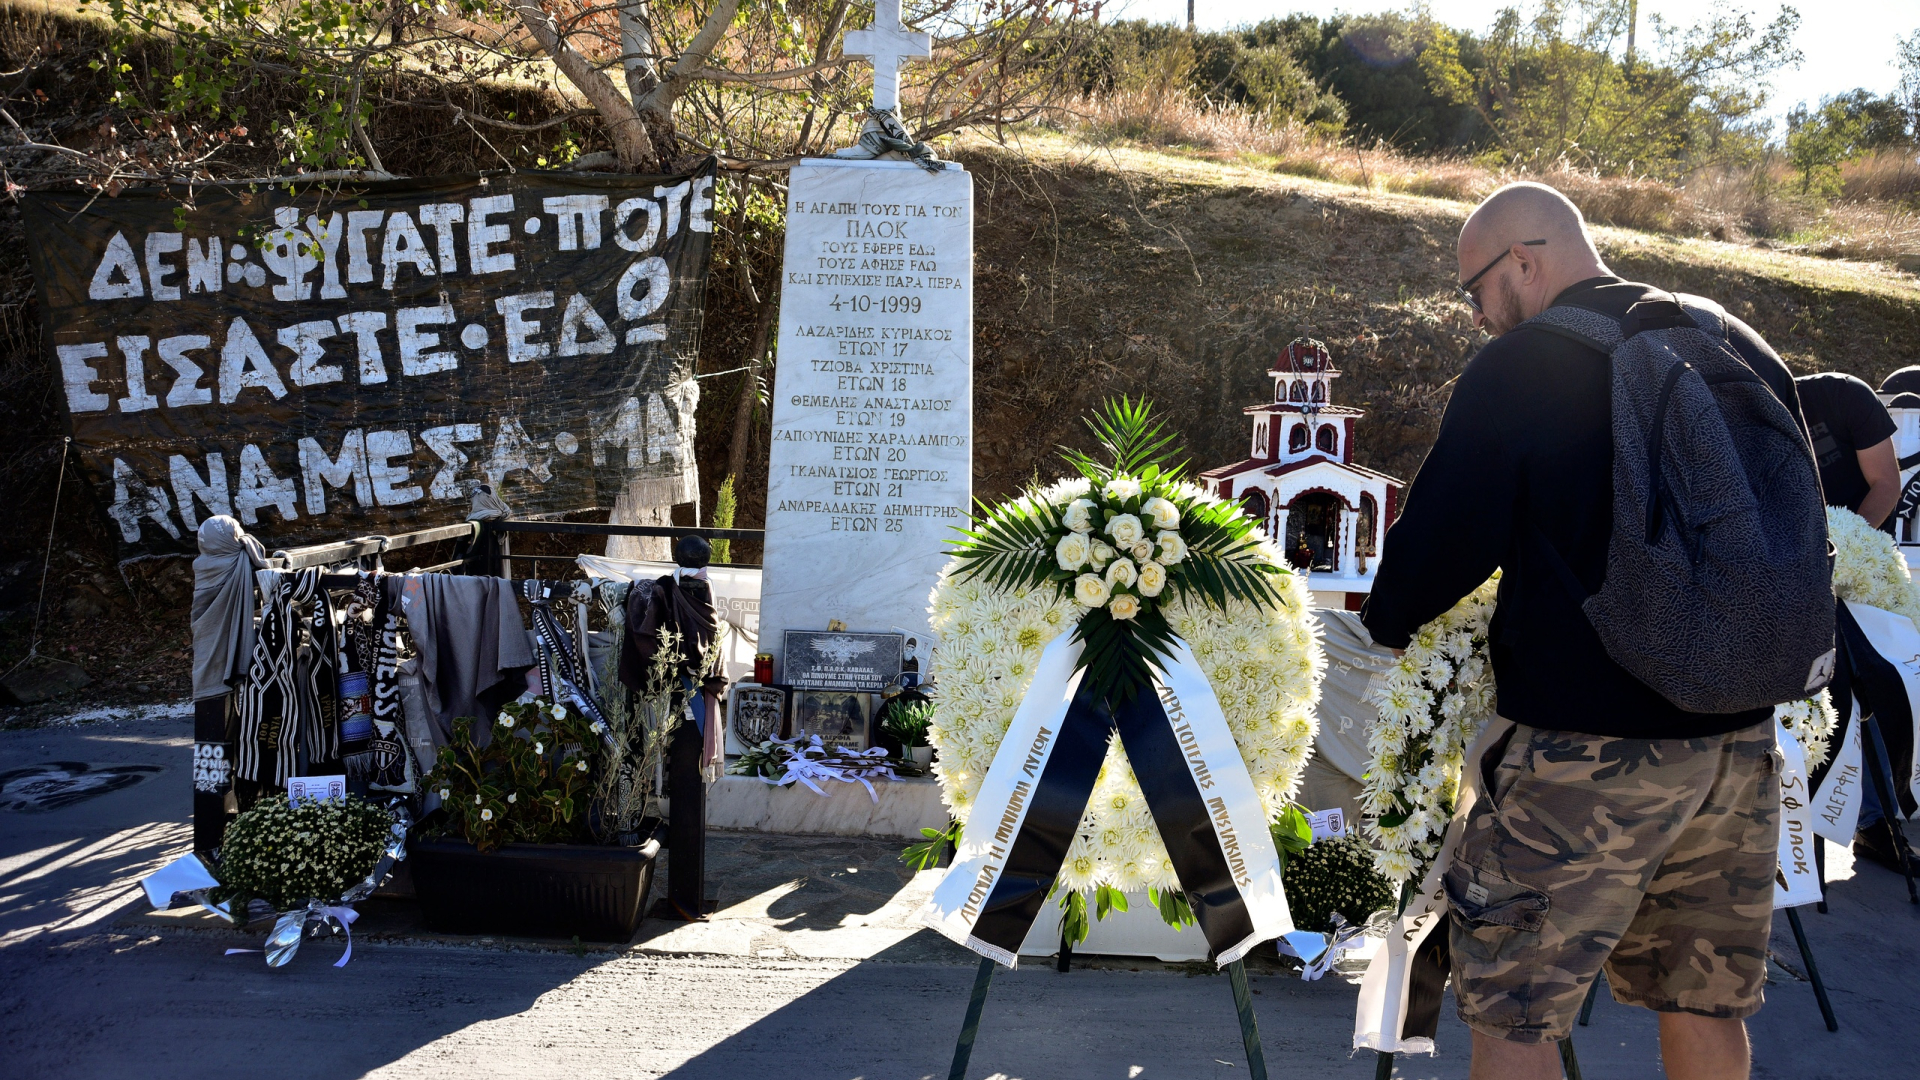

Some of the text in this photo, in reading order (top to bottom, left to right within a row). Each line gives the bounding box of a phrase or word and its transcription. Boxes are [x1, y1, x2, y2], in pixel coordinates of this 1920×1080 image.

[795, 201, 962, 218] Η ΑΓΑΠΗ ΤΟΥΣ ΓΙΑ ΤΟΝ
[89, 175, 713, 300] ΔΕΝ ΦΥΓΑΤΕ ΠΟΤΕ
[845, 219, 909, 239] ΠΑΟΚ
[822, 241, 936, 256] ΤΟΥΣ ΕΦΕΡΕ ΕΔΩ
[817, 257, 856, 270] ΤΟΥΣ
[860, 258, 905, 271] ΑΦΗΣΕ
[788, 272, 963, 290] ΚΑΙ ΣΥΝΕΧΙΣΕ ΠΑΡΑ ΠΕΡΑ
[829, 293, 922, 314] 4-10-1999
[58, 256, 671, 413] ΕΙΣΑΣΤΕ ΕΔΩ
[795, 325, 952, 342] ΛΑΖΑΡΙΔΗΣ ΚΥΡΙΑΚΟΣ
[838, 341, 909, 358] ΕΤΩΝ 17
[811, 359, 935, 376] ΤΖΙΟΒΑ ΧΡΙΣΤΙΝΑ
[838, 375, 907, 392] ΕΤΩΝ 18
[791, 395, 952, 412] ΘΕΜΕΛΗΣ ΑΝΑΣΤΑΣΙΟΣ
[836, 410, 906, 428] ΕΤΩΝ 19
[773, 429, 968, 447] ΖΑΠΟΥΝΙΔΗΣ ΧΑΡΑΛΑΜΠΟΣ
[833, 445, 907, 463] ΕΤΩΝ 20
[107, 415, 554, 543] ΑΝΑΜΕΣΑ
[791, 465, 949, 483] ΓΚΑΝΑΤΣΙΟΣ ΓΕΩΡΓΙΟΣ
[833, 481, 903, 498] ΕΤΩΝ 21
[777, 499, 959, 518] ΑΝΔΡΕΑΔΑΚΗΣ ΔΗΜΗΤΡΗΣ
[830, 516, 903, 533] ΕΤΩΝ 25
[1157, 685, 1253, 891] ΑΡΙΣΤΟΤΕΛΗΣ ΜΥΣΤΑΚΙΔΗΣ
[1820, 764, 1859, 826] ΑΔΕΡΦΙΑ
[994, 780, 1032, 844] ΜΝΗΜΗ
[989, 844, 1006, 860] Η
[1786, 820, 1810, 875] ΠΑΟΚ
